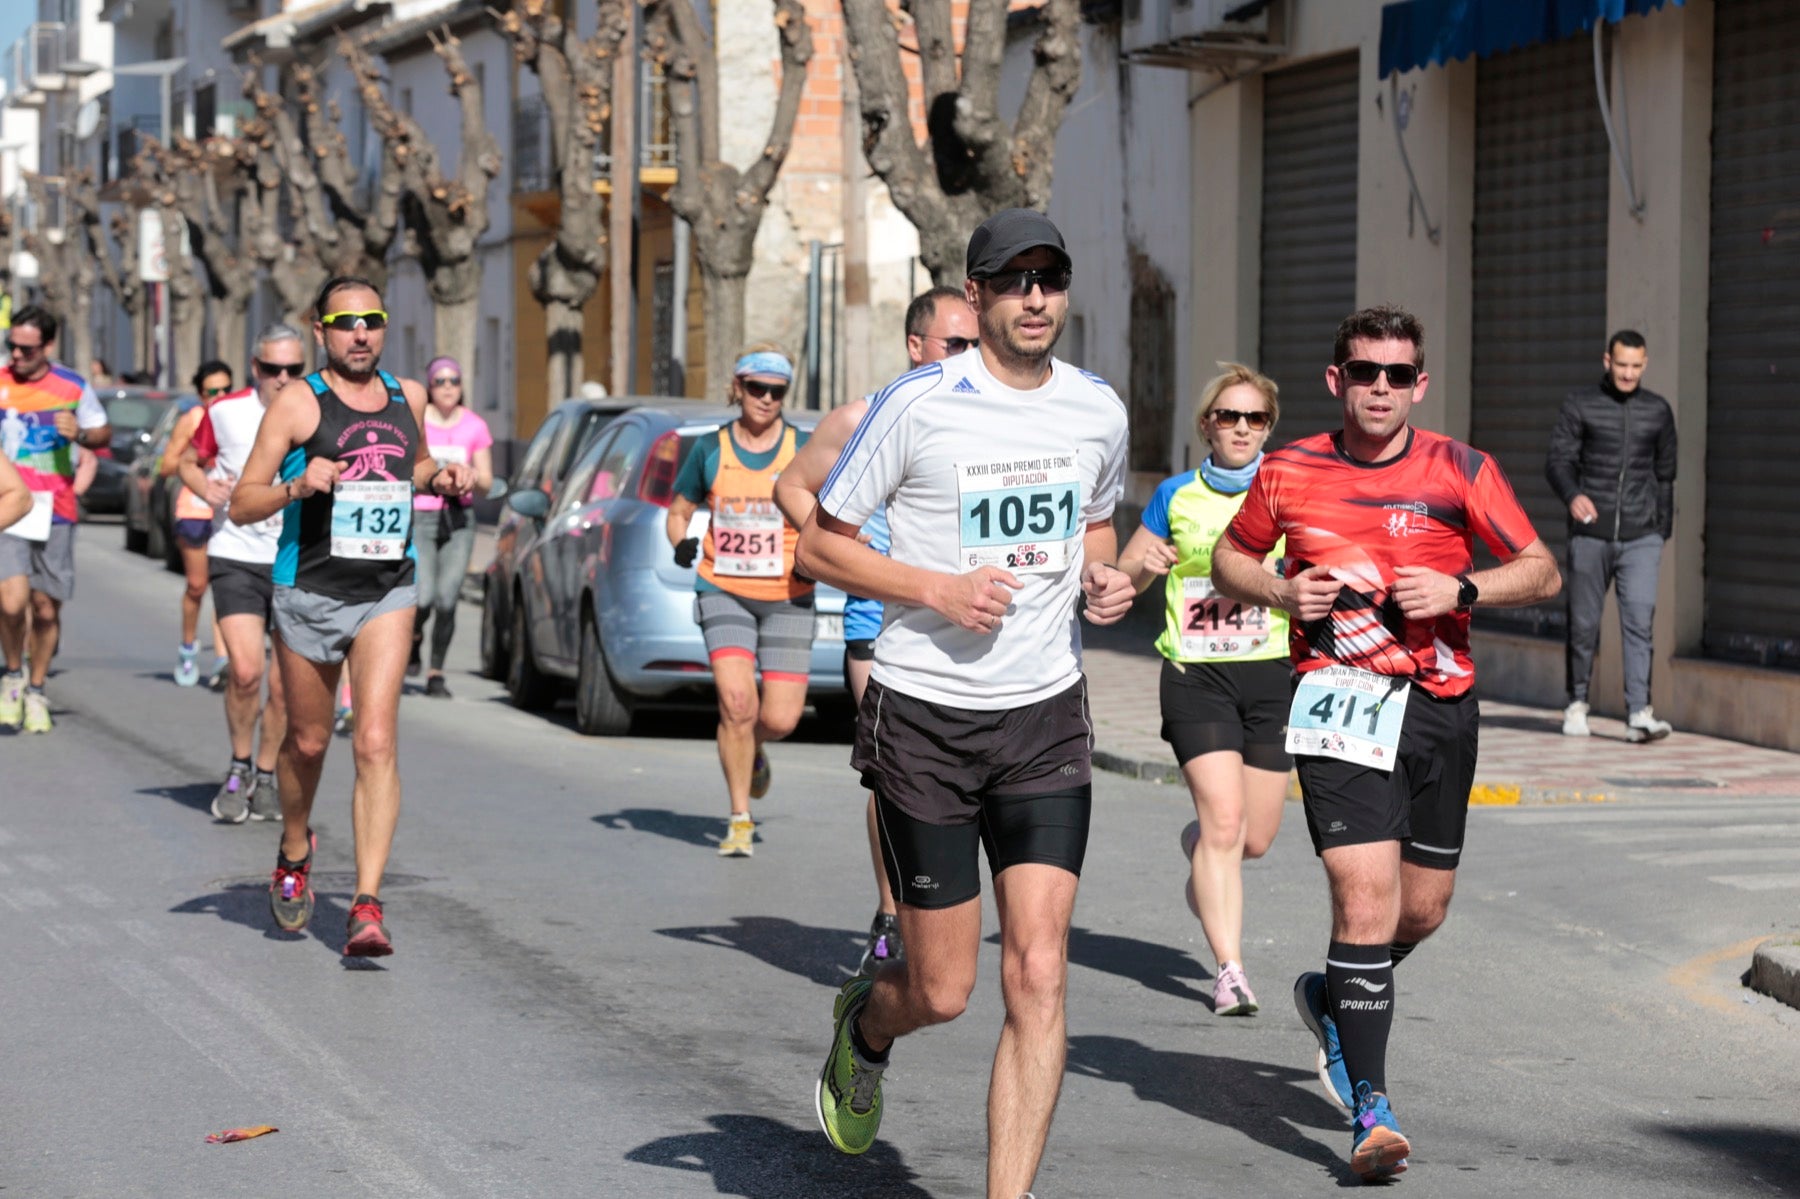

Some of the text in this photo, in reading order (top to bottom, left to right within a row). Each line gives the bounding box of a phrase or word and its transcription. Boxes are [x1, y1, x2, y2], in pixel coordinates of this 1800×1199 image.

[966, 464, 989, 477] XXXIII
[991, 462, 1012, 475] GRAN
[1013, 459, 1042, 472] PREMIO
[1042, 459, 1052, 470] DE
[970, 489, 1074, 539] 1051
[1382, 503, 1416, 511] ATLETISMO
[350, 507, 402, 534] 132
[720, 532, 776, 555] 2251
[1187, 602, 1265, 631] 2144
[1308, 693, 1382, 736] 411
[1340, 999, 1390, 1010] SPORTLAST
